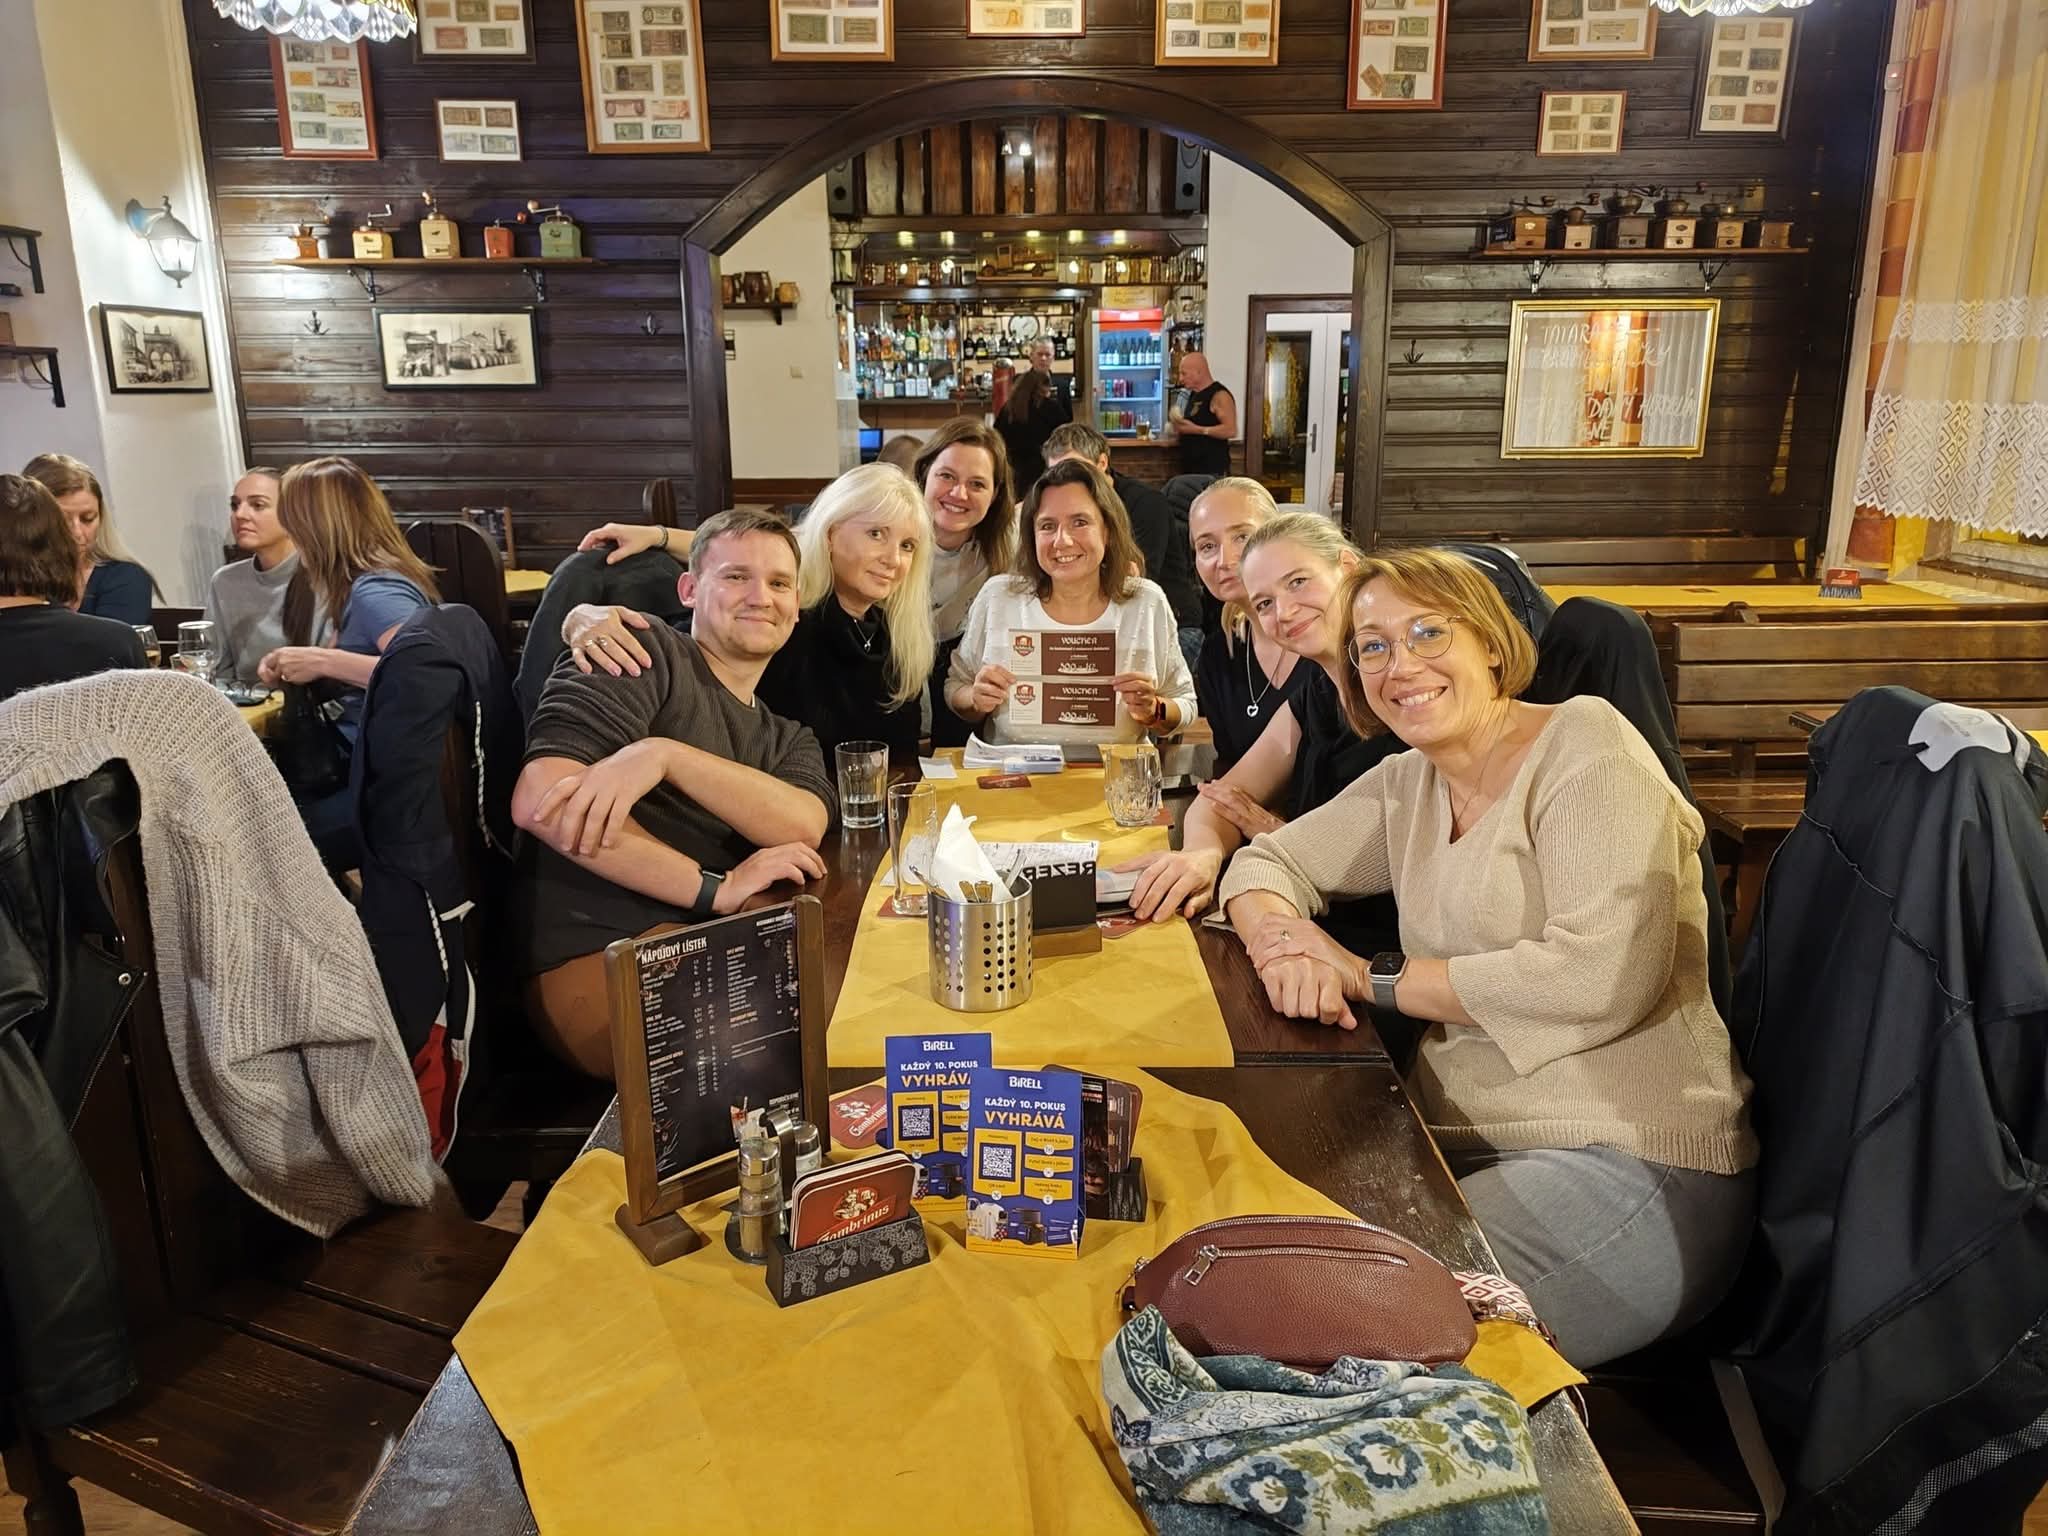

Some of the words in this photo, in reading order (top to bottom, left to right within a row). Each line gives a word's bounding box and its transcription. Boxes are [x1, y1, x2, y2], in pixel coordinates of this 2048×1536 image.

[641, 942, 681, 965] NÁPOJOVÝ
[682, 936, 707, 953] LÍSTEK
[900, 1061, 931, 1071] KAŽDÝ
[934, 1061, 947, 1070] 10.
[948, 1060, 978, 1069] POKUS
[984, 1096, 1017, 1108] KAŽDÝ
[1020, 1100, 1033, 1109] 10.
[1034, 1101, 1066, 1111] POKUS
[984, 1110, 1065, 1129] VYHRÁVÁ
